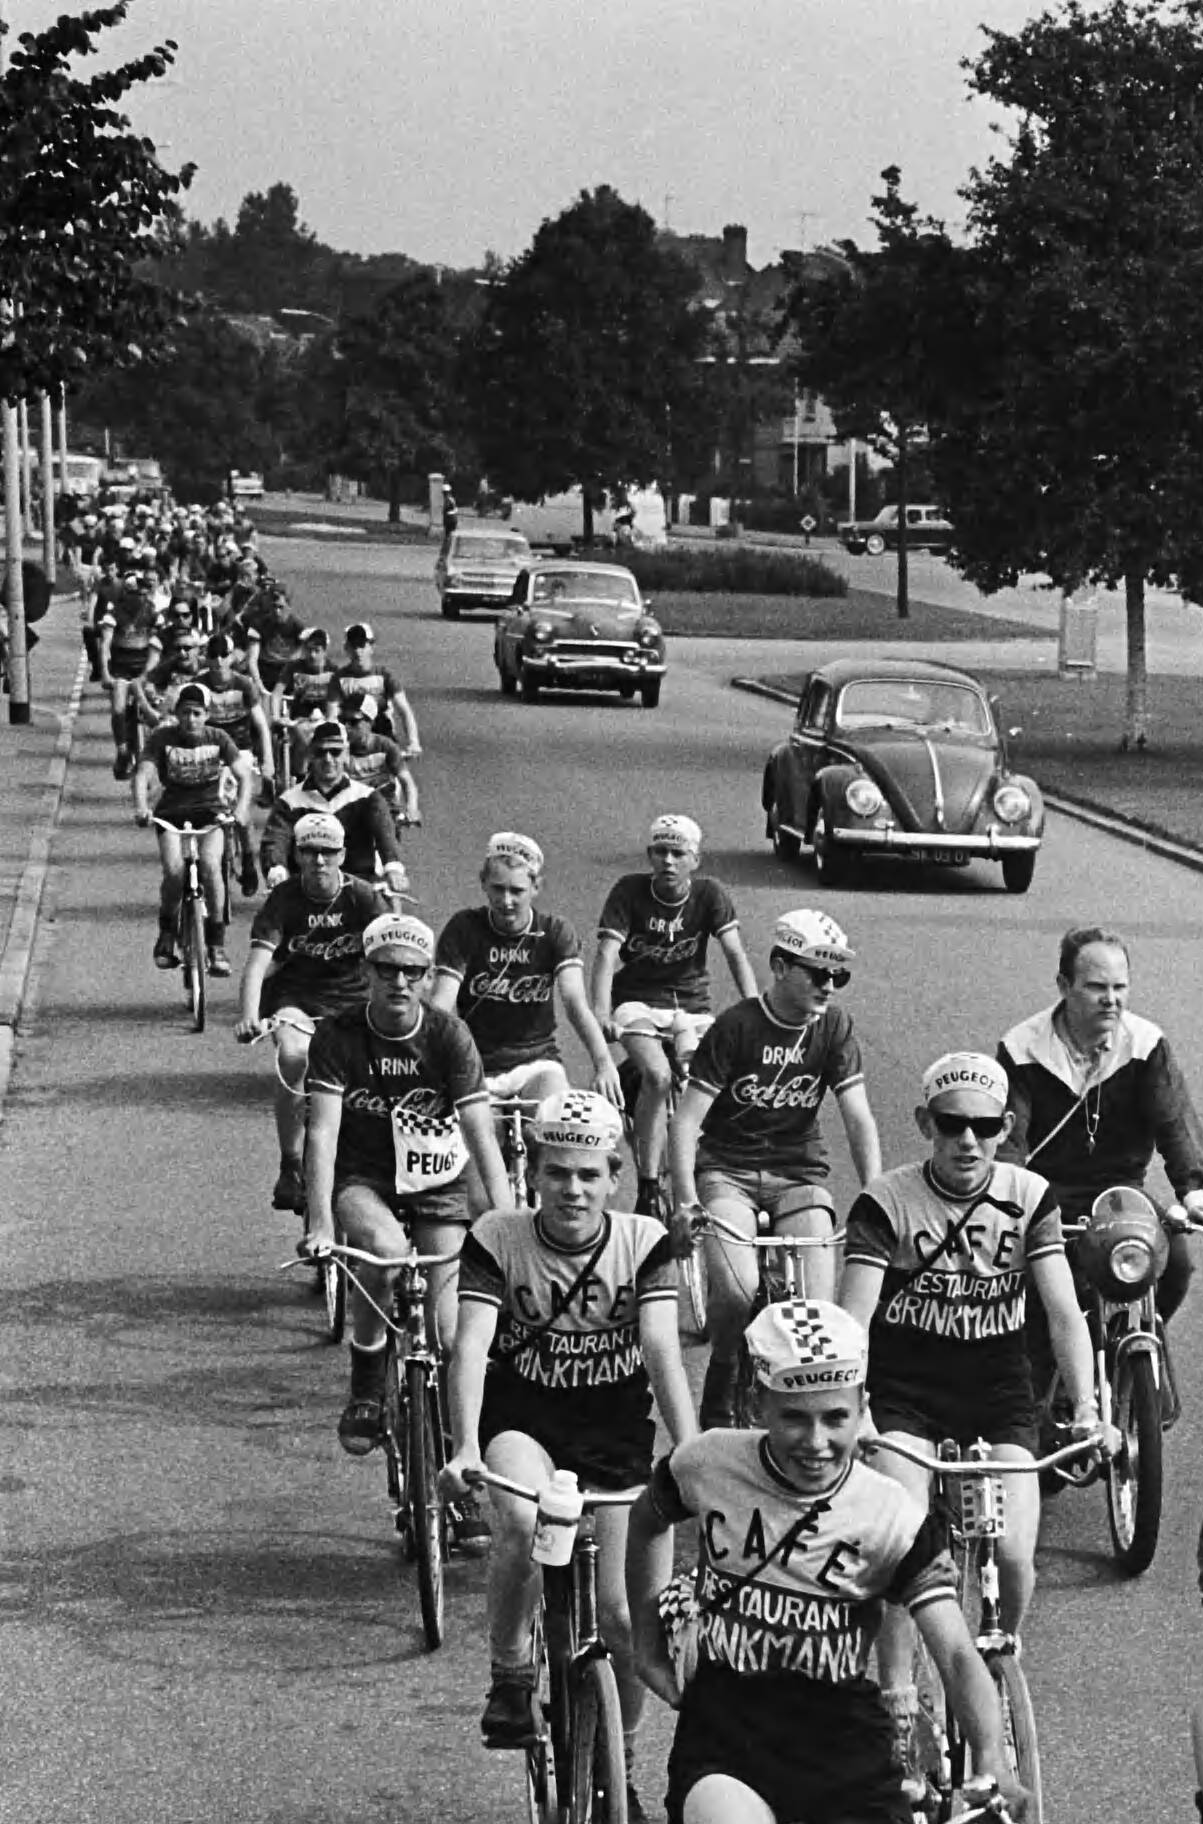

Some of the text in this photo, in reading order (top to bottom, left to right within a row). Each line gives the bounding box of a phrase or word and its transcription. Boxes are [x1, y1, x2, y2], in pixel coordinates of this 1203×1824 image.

[935, 1070, 995, 1090] PEUGEOT
[884, 1287, 1027, 1341] BRINKMANN
[699, 1611, 863, 1682] RINKMANN
